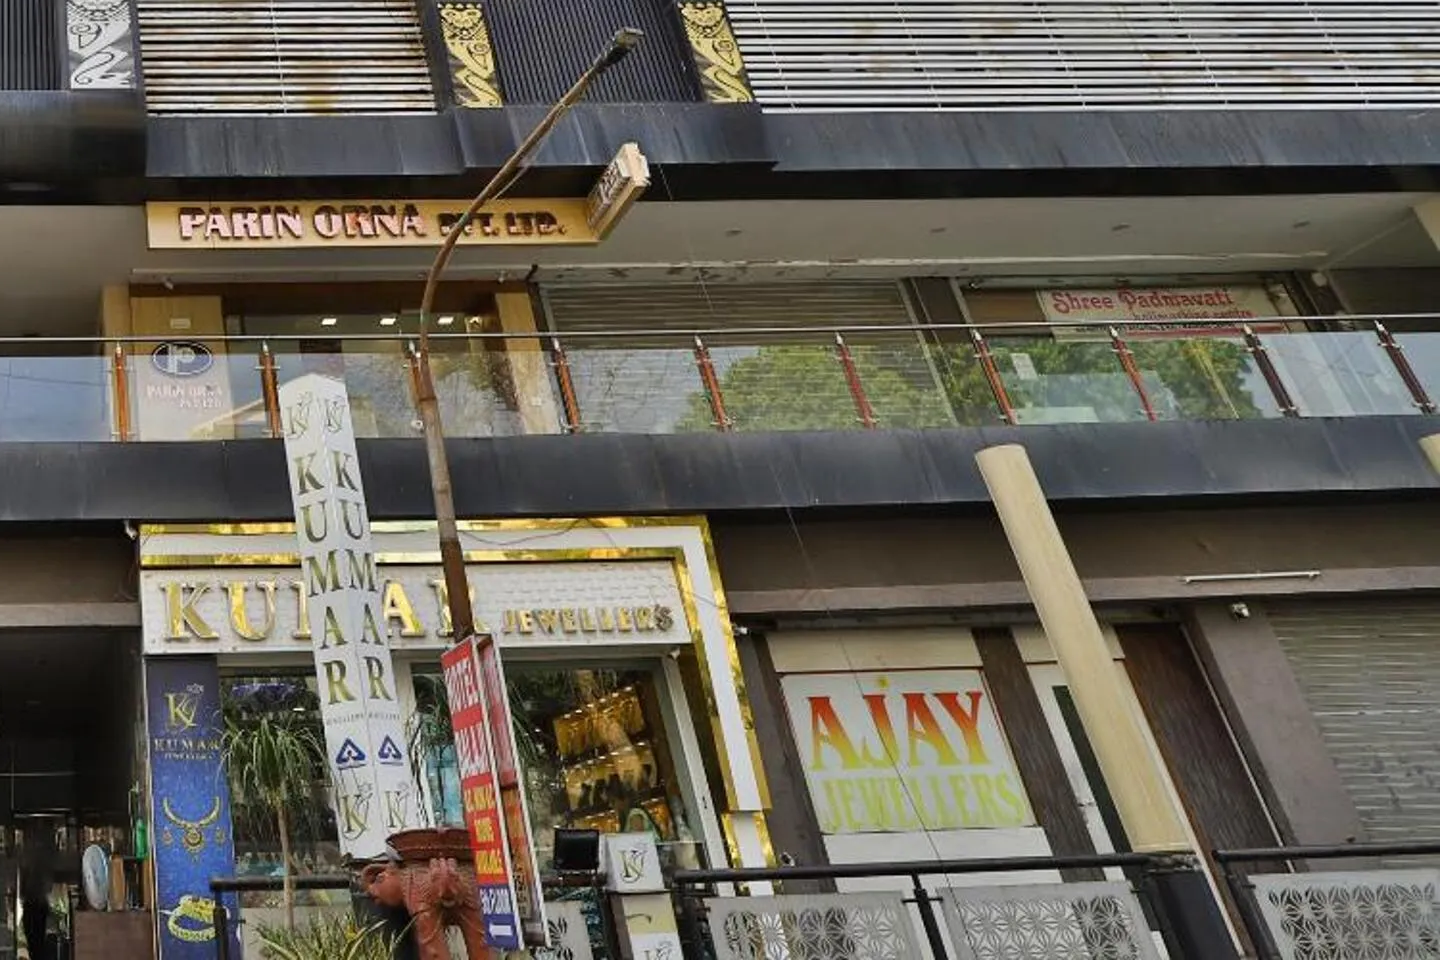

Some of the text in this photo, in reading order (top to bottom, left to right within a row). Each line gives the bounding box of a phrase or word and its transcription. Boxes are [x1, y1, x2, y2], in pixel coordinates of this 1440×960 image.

[177, 205, 304, 239] PARIN
[313, 203, 427, 239] ORNA
[1050, 291, 1115, 314] Shree
[293, 450, 357, 705] KUMAR
[330, 450, 394, 701] KUMAR
[160, 577, 491, 640] KUAR
[807, 691, 990, 771] AJAY
[822, 771, 1025, 834] JEWELLERS
